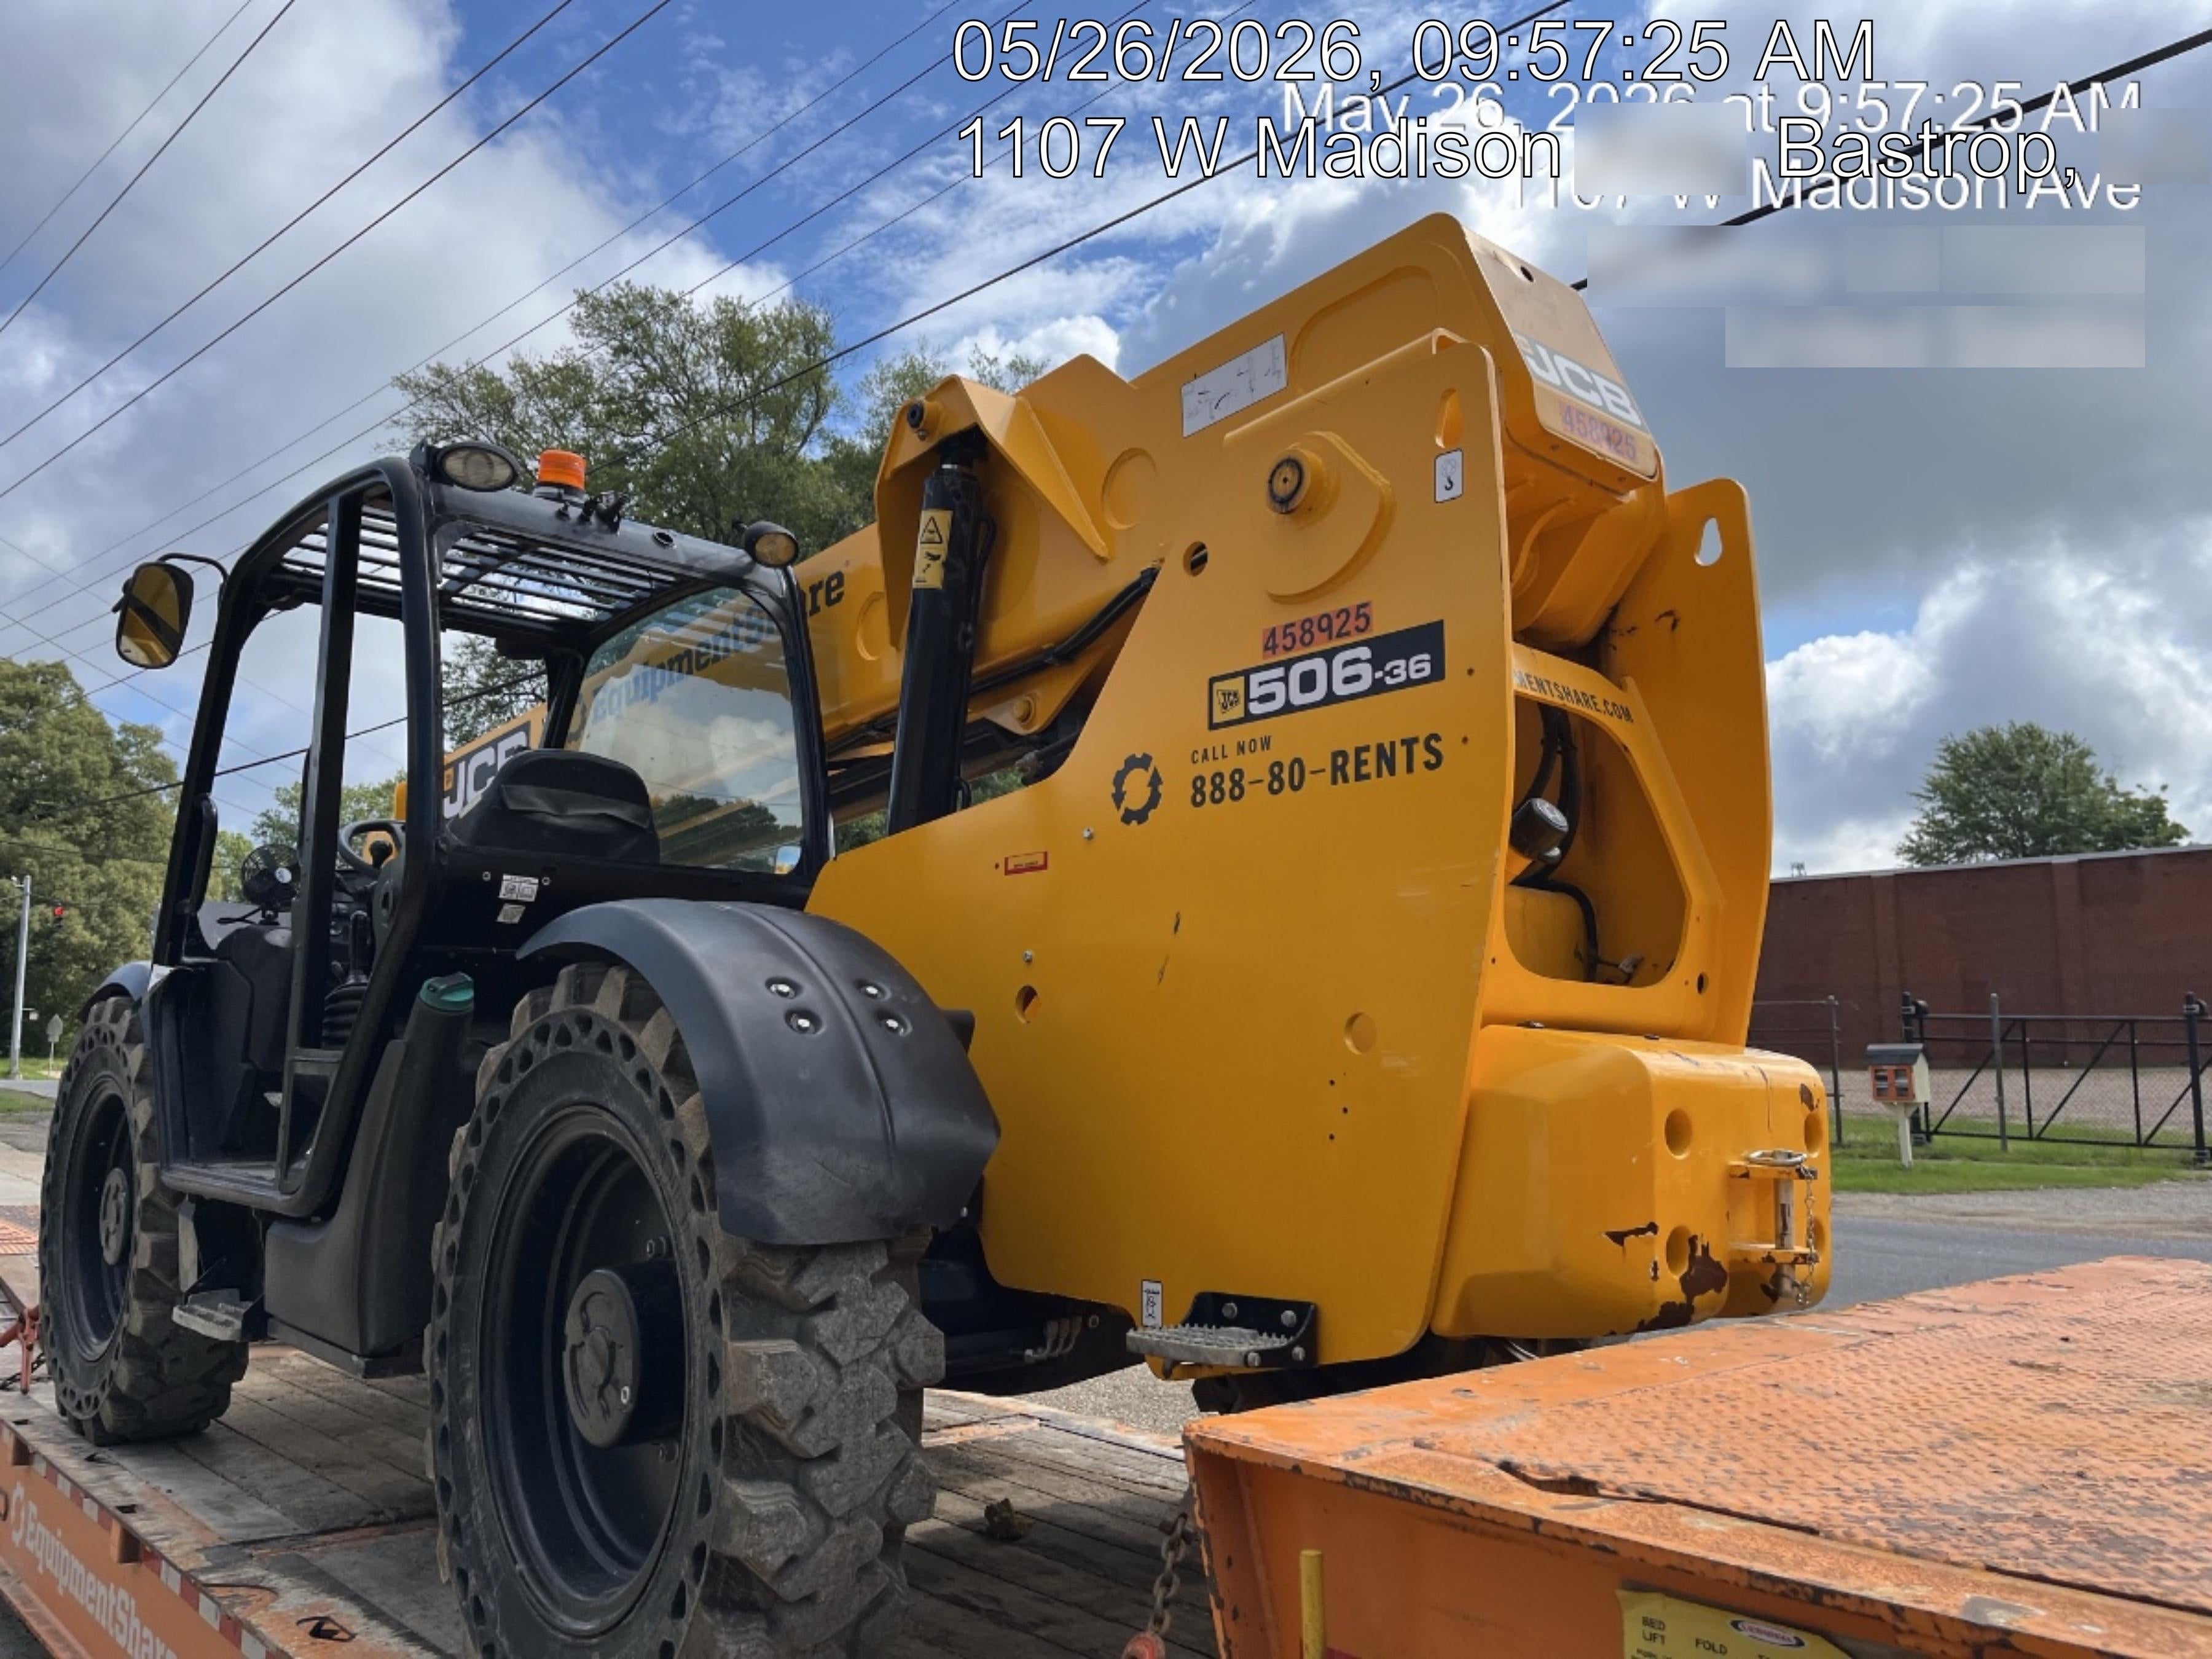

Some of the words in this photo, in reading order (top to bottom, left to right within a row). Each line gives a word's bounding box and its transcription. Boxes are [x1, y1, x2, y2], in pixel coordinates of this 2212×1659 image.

[1524, 343, 1642, 426] JCB
[1263, 601, 1371, 656] 458925
[1248, 645, 1432, 715] 506-36
[1190, 732, 1444, 809] 888-80-RENTS
[1191, 746, 1229, 765] CALL
[1236, 735, 1272, 755] NOW
[25, 1499, 178, 1659] EquipmentShar
[1641, 1616, 1666, 1631] BED
[1642, 1630, 1666, 1645] LIFT
[1695, 1637, 1728, 1655] FOLD
